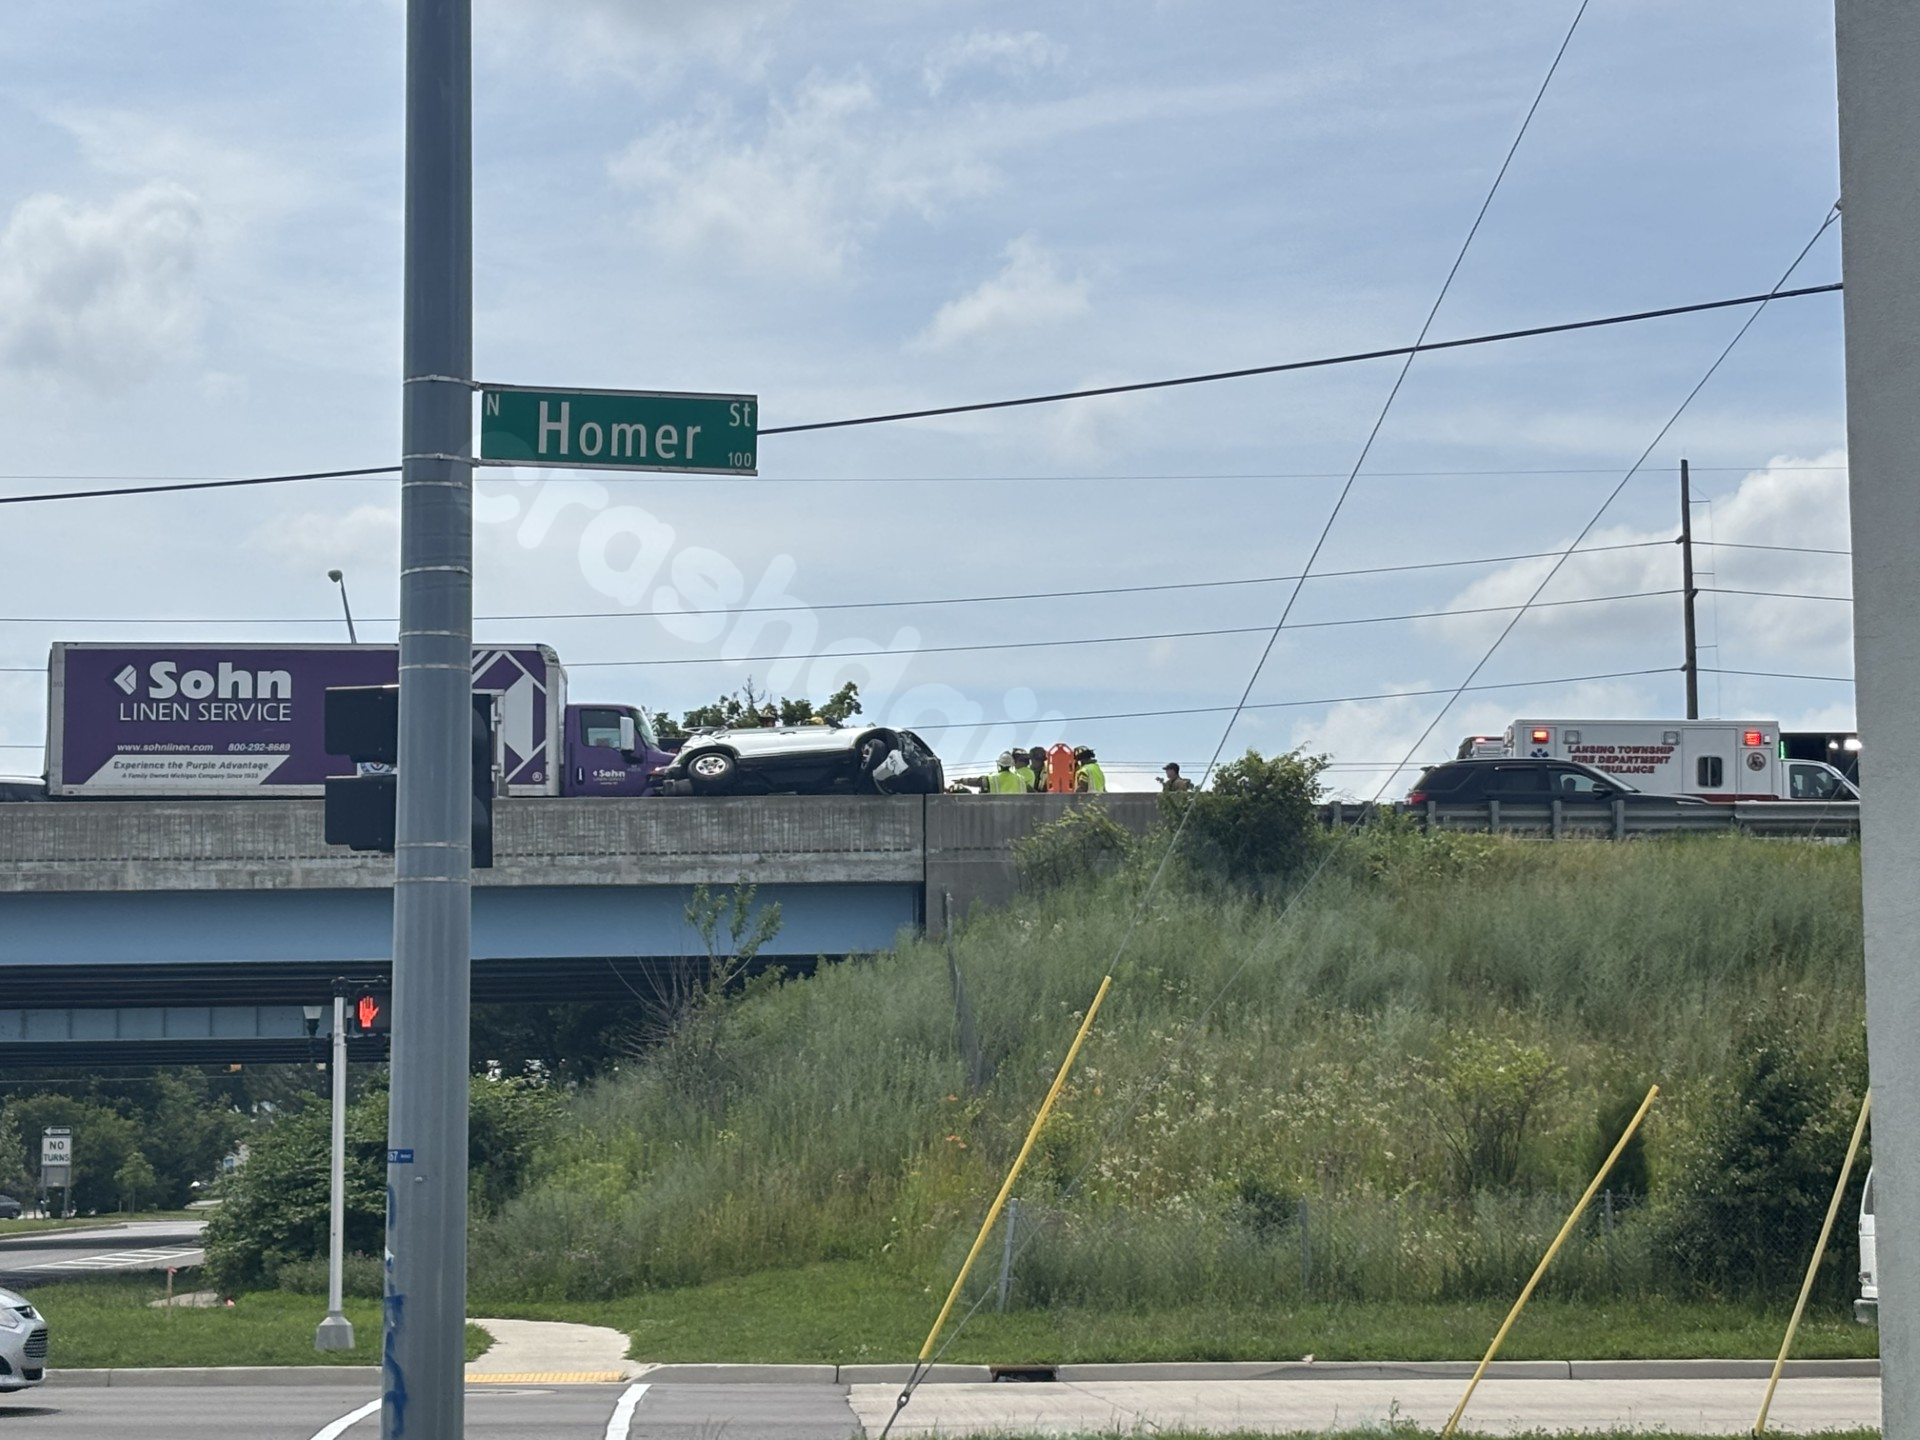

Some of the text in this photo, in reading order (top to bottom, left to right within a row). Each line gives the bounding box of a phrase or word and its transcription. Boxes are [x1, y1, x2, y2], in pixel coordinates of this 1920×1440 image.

[486, 394, 751, 460] N Homer St
[727, 452, 751, 467] 100
[148, 660, 292, 700] Sohn
[119, 702, 292, 722] LINEN SERVICE
[116, 742, 214, 752] www.sohnlinen.com
[1567, 745, 1675, 754] LANSING TOWNSHIP
[1571, 755, 1671, 764] FIRE DEPARTMENT
[113, 761, 165, 771] Experience
[167, 761, 183, 769] the
[185, 761, 216, 771] Purple
[599, 769, 626, 778] Sohn
[49, 1140, 65, 1150] NO
[43, 1153, 70, 1162] TURNS
